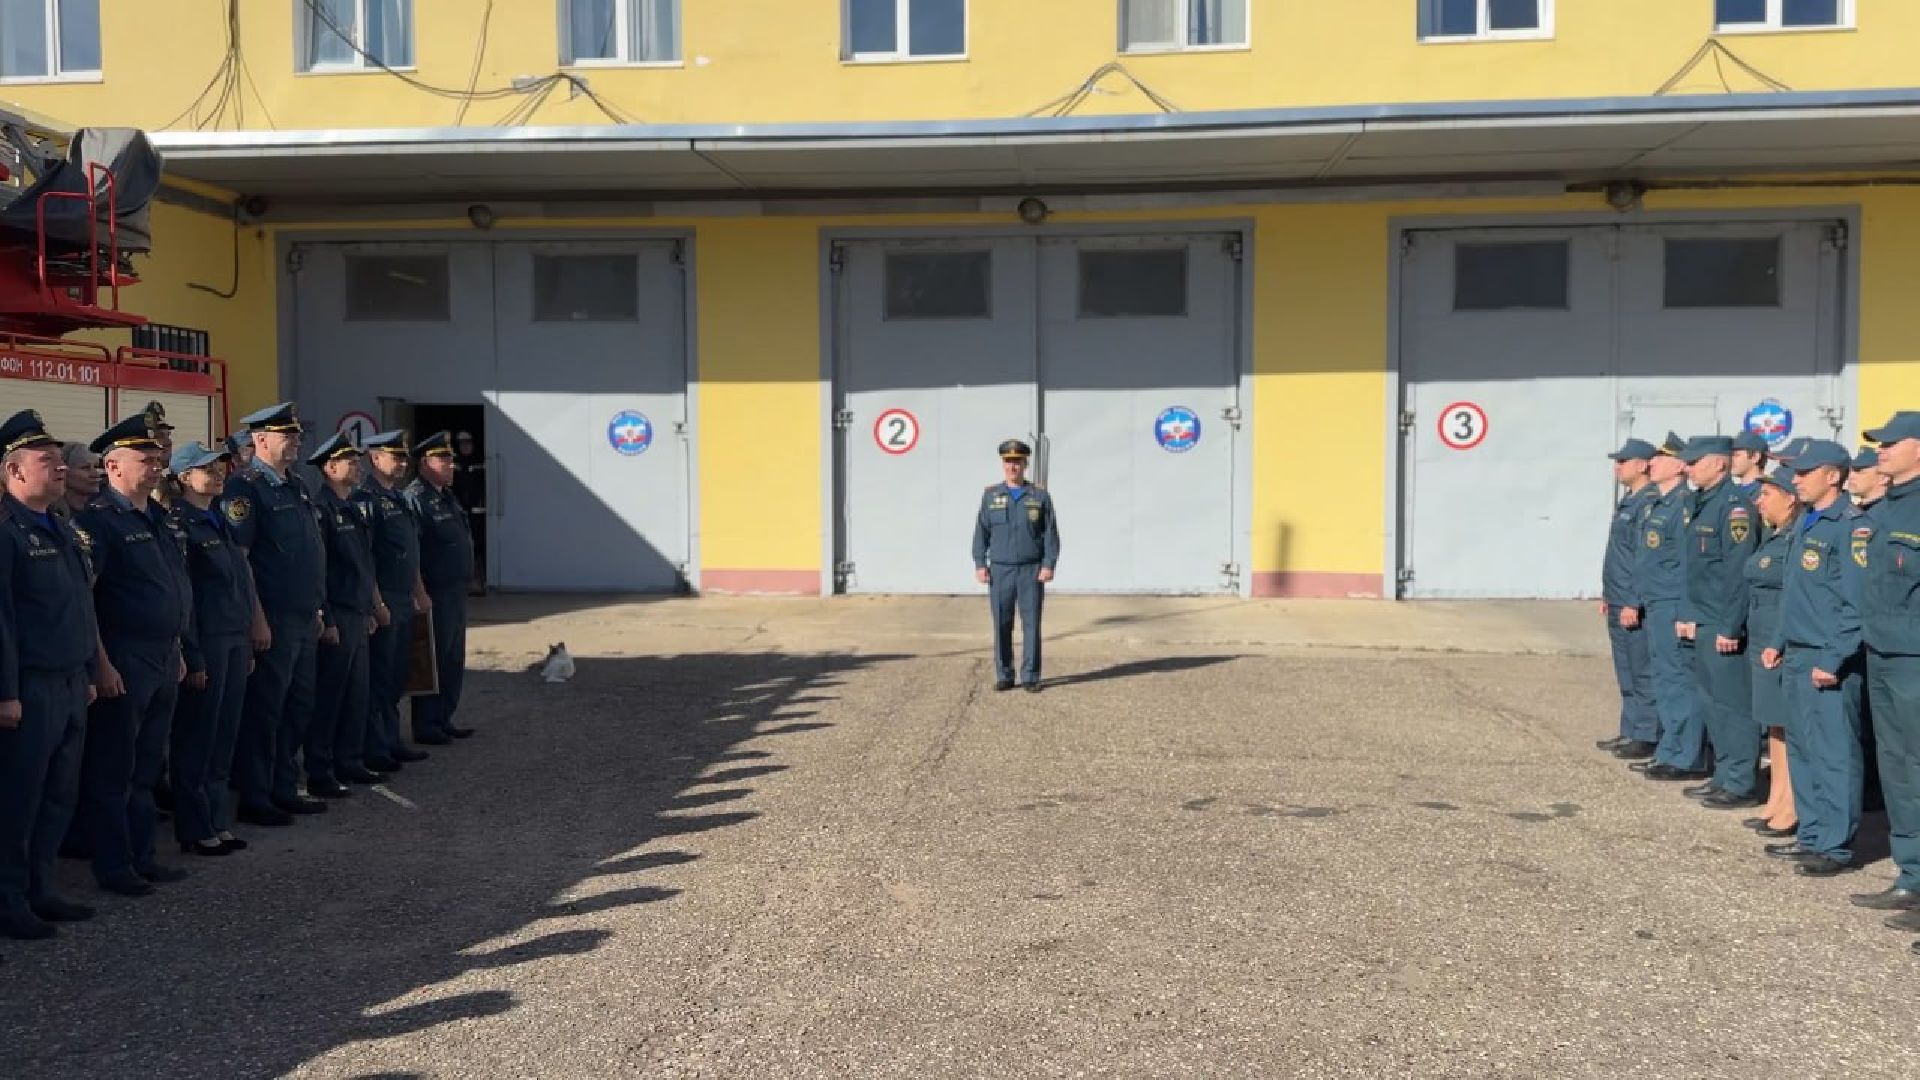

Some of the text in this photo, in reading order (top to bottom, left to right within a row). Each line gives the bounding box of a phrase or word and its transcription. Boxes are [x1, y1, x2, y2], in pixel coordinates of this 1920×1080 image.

[350, 420, 362, 449] 1
[888, 417, 906, 445] 2
[1453, 411, 1473, 440] 3
